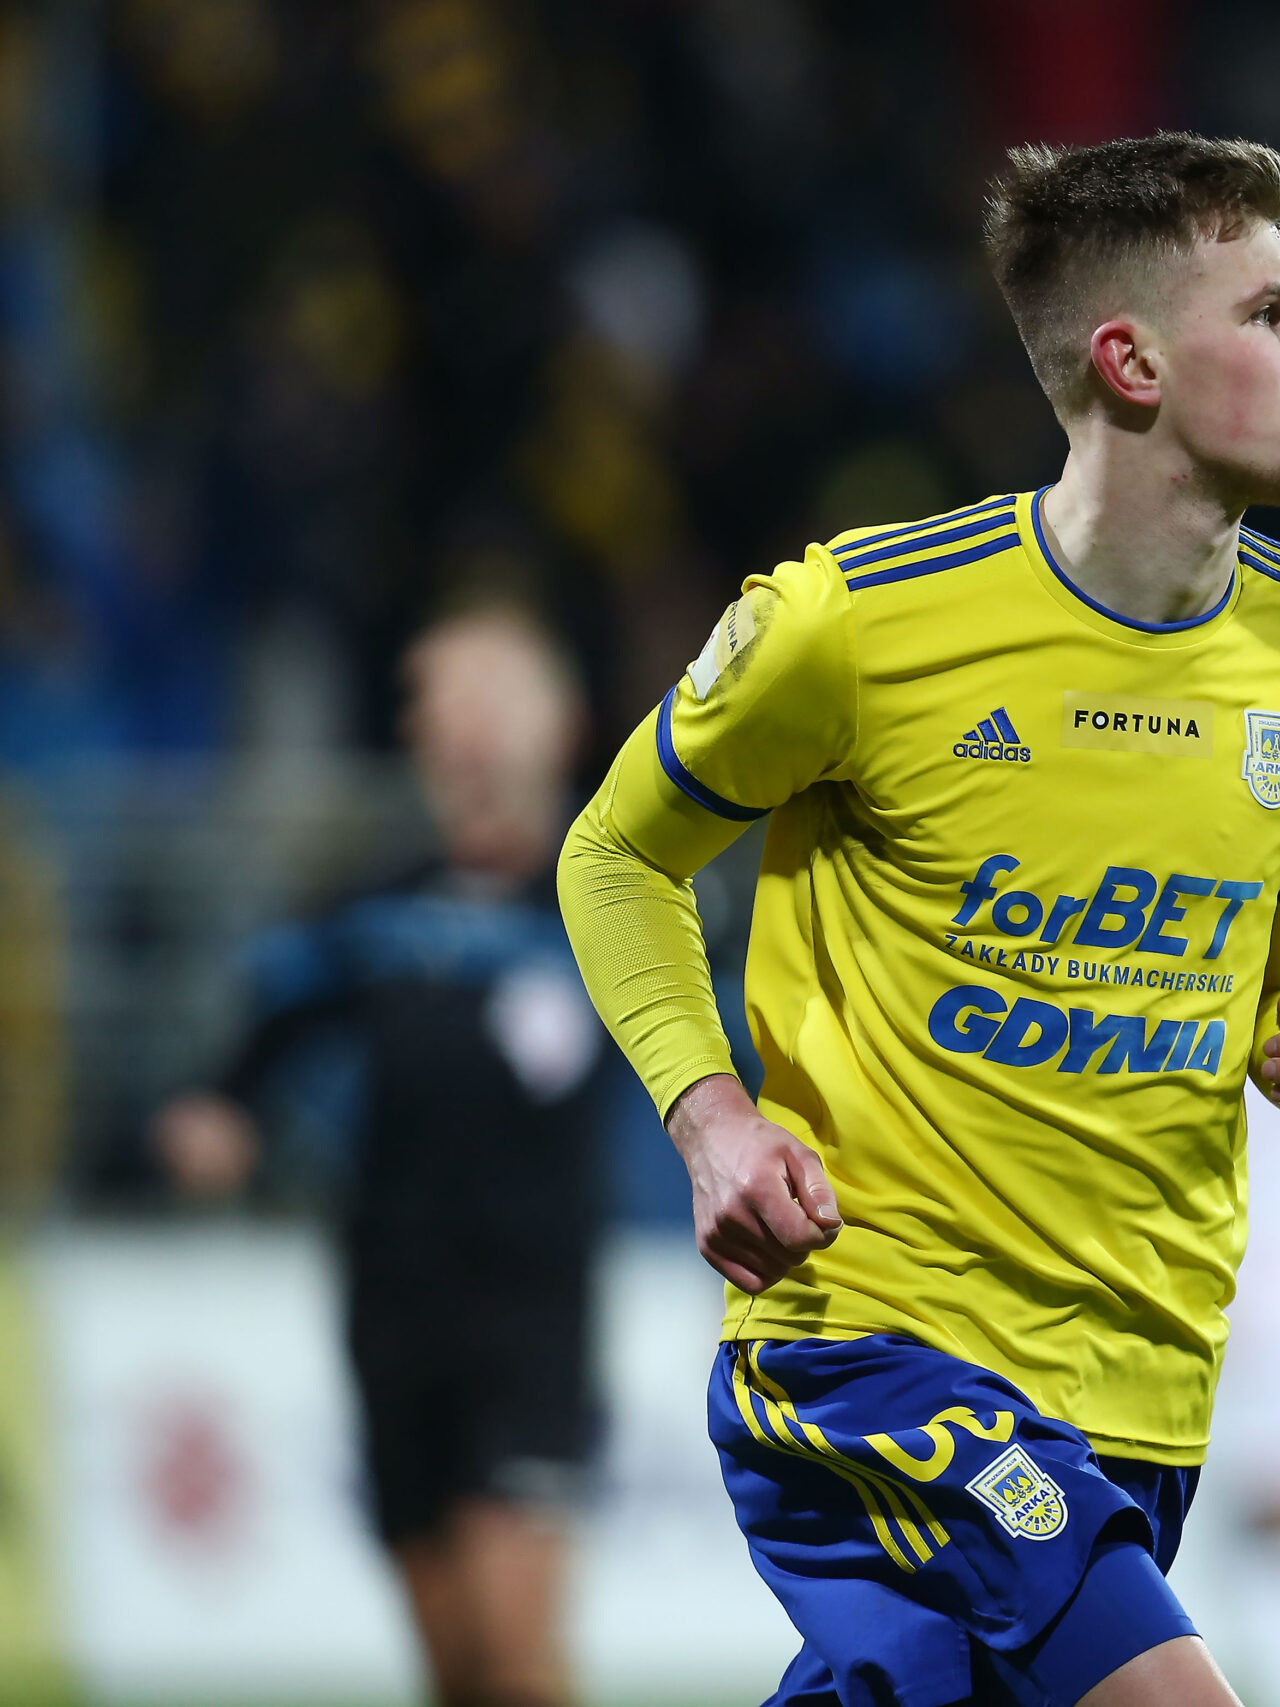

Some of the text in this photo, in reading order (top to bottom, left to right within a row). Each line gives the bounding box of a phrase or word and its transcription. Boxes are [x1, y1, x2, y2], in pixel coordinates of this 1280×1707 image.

[727, 602, 738, 653] RTUNA
[1074, 710, 1201, 739] FORTUNA
[952, 740, 1032, 763] adidas
[950, 854, 1265, 960] forBET
[944, 934, 1235, 993] ZAKŁADY BUKMACHERSKIE
[928, 984, 1227, 1077] GDYNIA
[1014, 1489, 1051, 1522] ARKA
